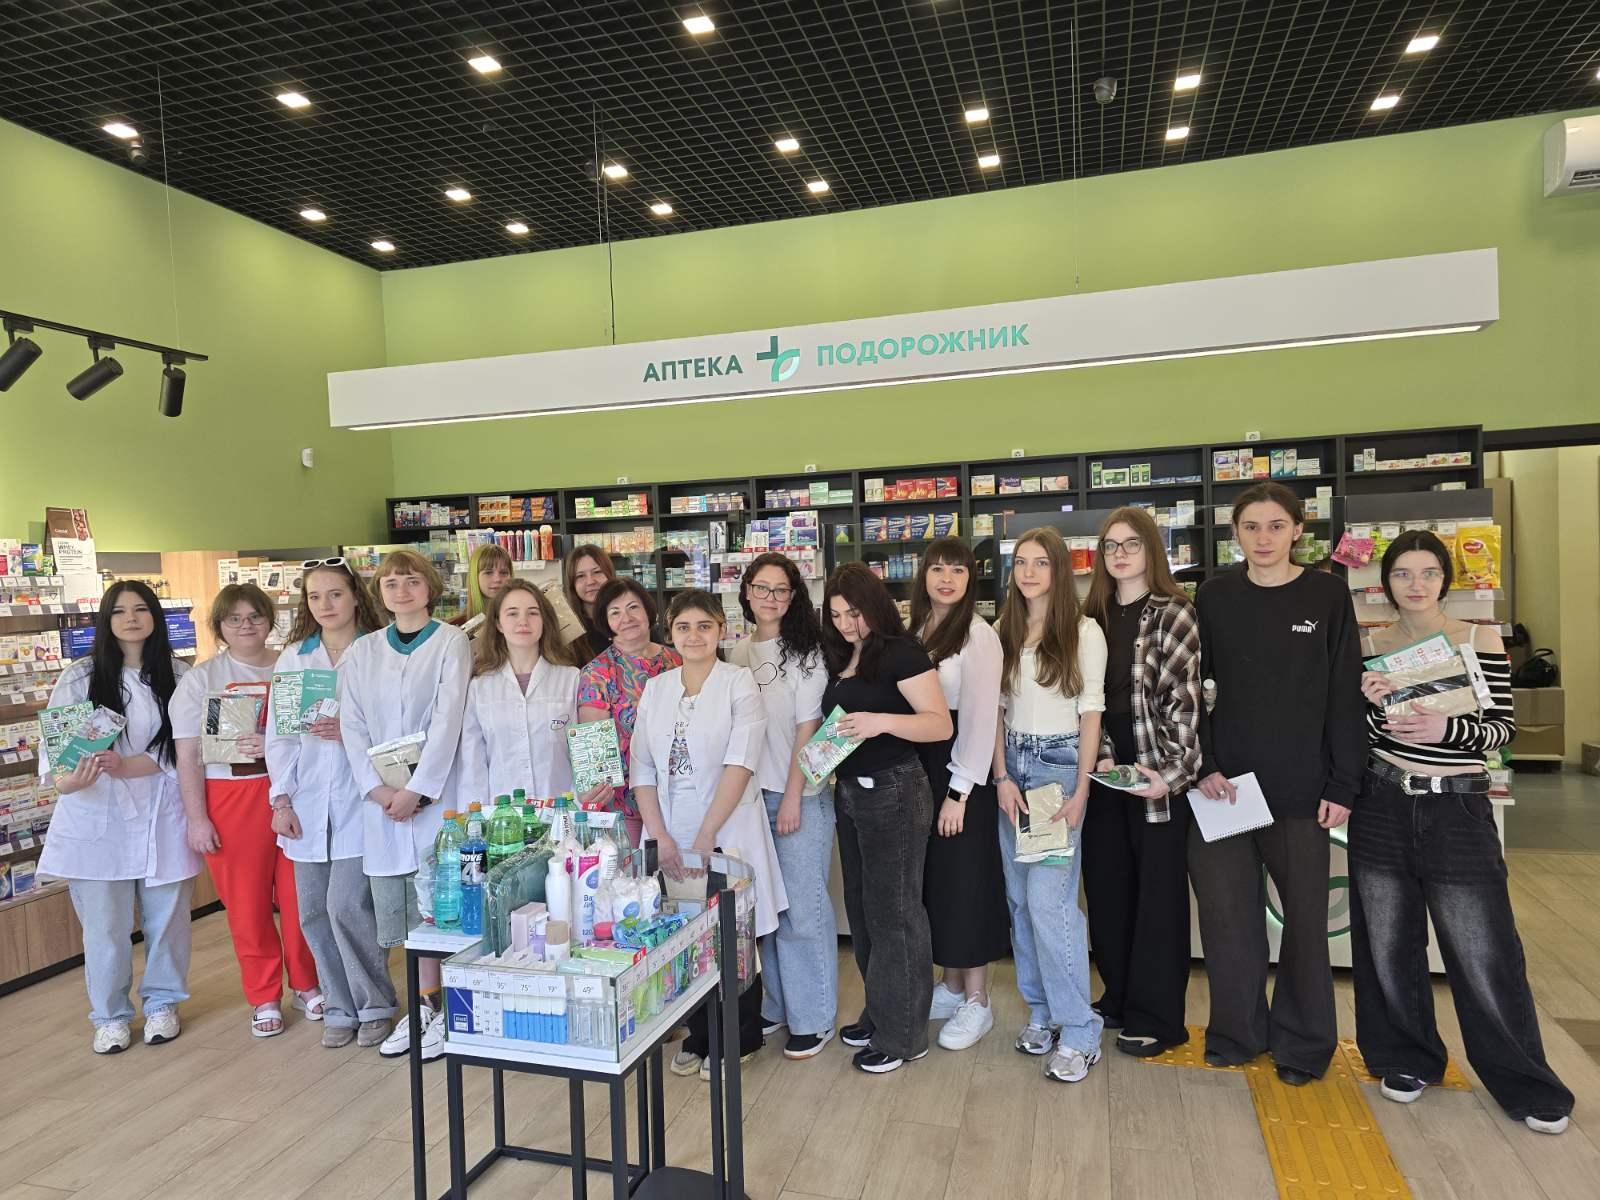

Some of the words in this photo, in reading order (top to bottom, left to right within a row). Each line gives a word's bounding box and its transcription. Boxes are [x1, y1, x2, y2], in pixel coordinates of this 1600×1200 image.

[642, 354, 743, 382] АПТЕКА
[816, 323, 1030, 366] ПОДОРОЖНИК
[1291, 624, 1312, 633] PUMA
